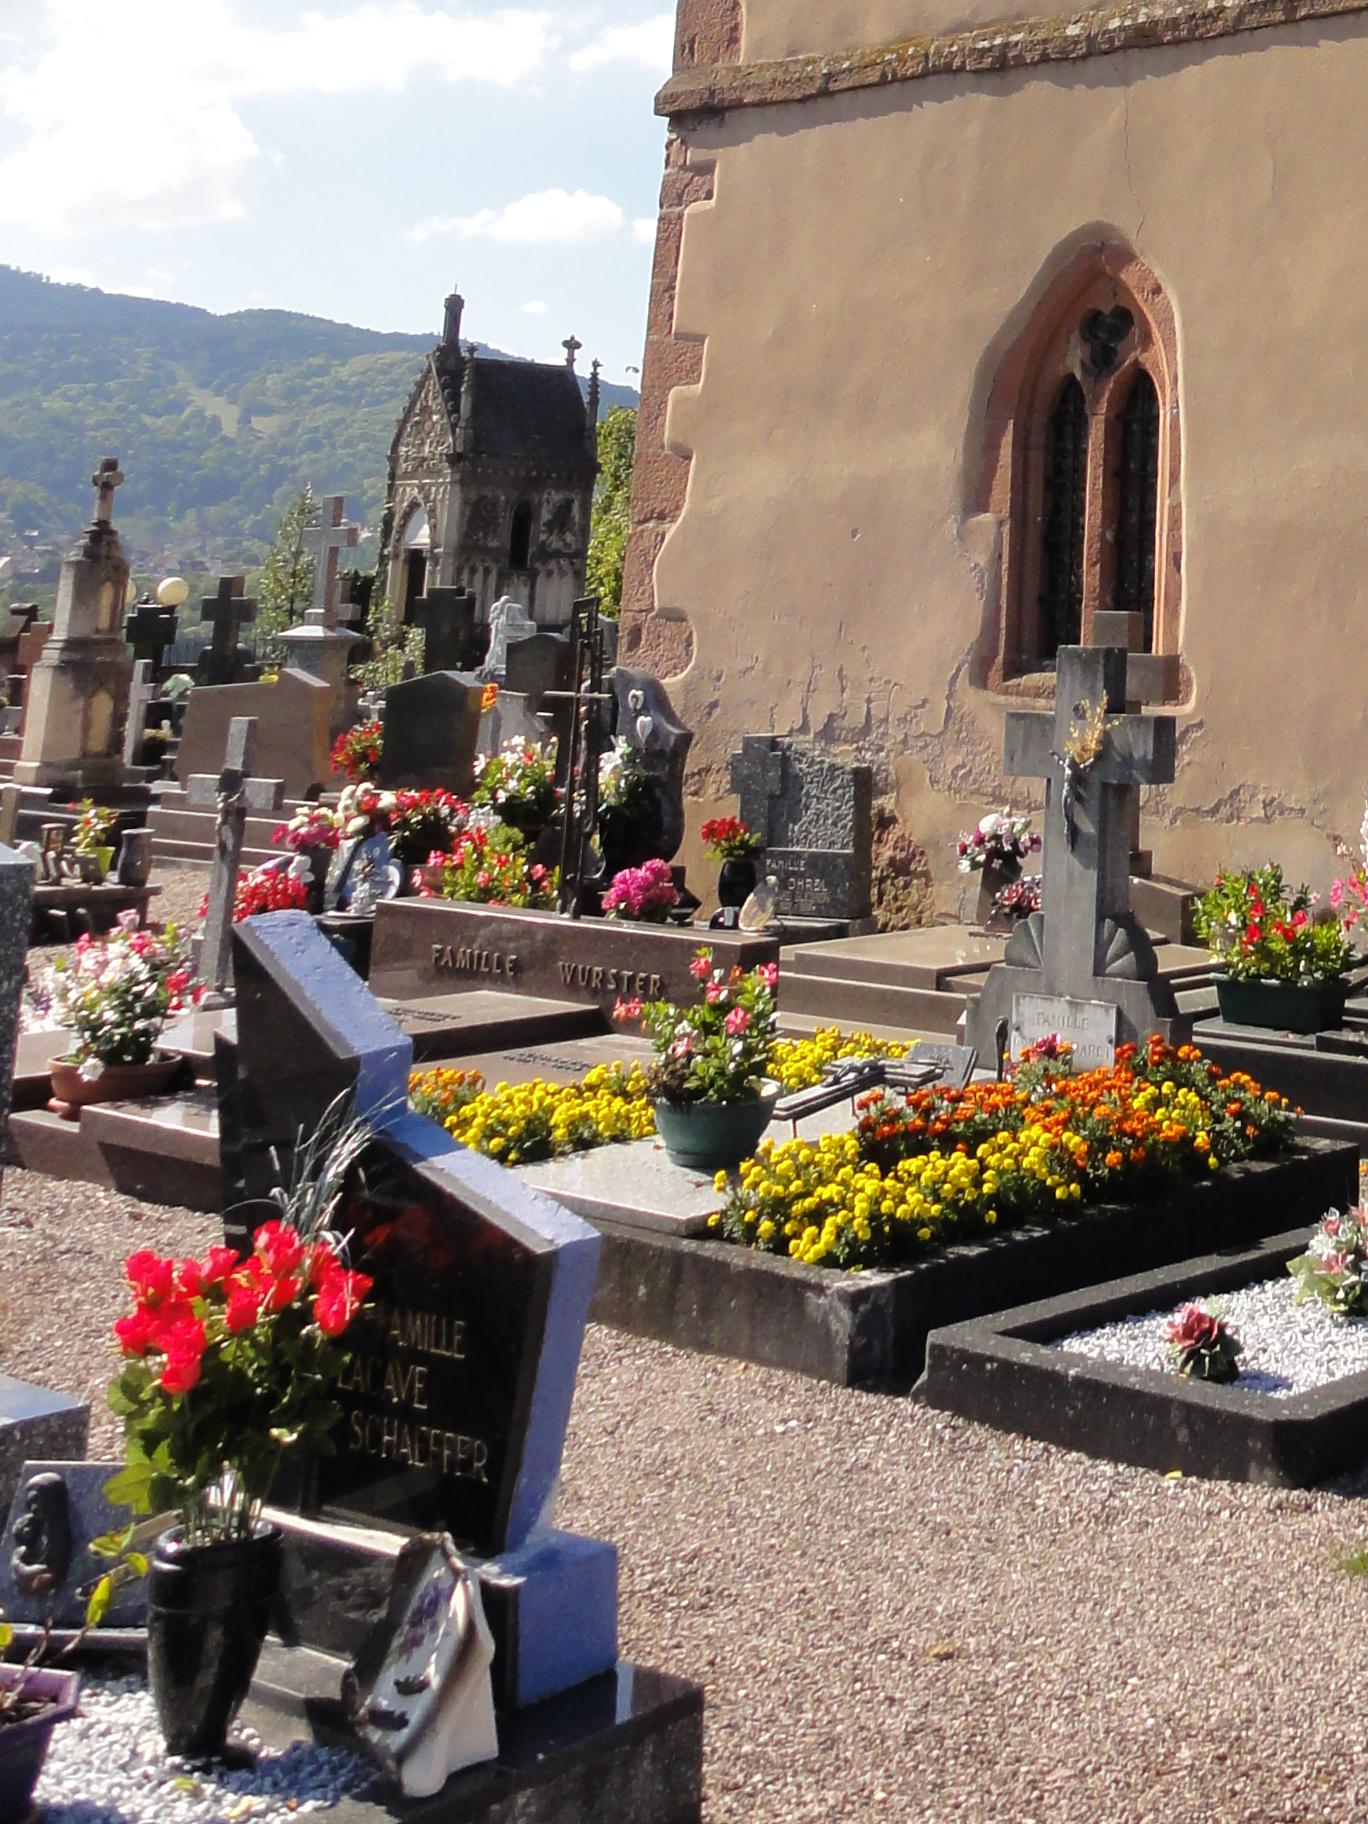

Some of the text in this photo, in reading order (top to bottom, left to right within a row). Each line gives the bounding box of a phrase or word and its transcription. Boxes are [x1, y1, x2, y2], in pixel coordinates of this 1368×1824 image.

[431, 943, 662, 996] FAMILLE WURSTER
[387, 1308, 467, 1359] AMILLE
[349, 1408, 490, 1484] SCHAEFFER
